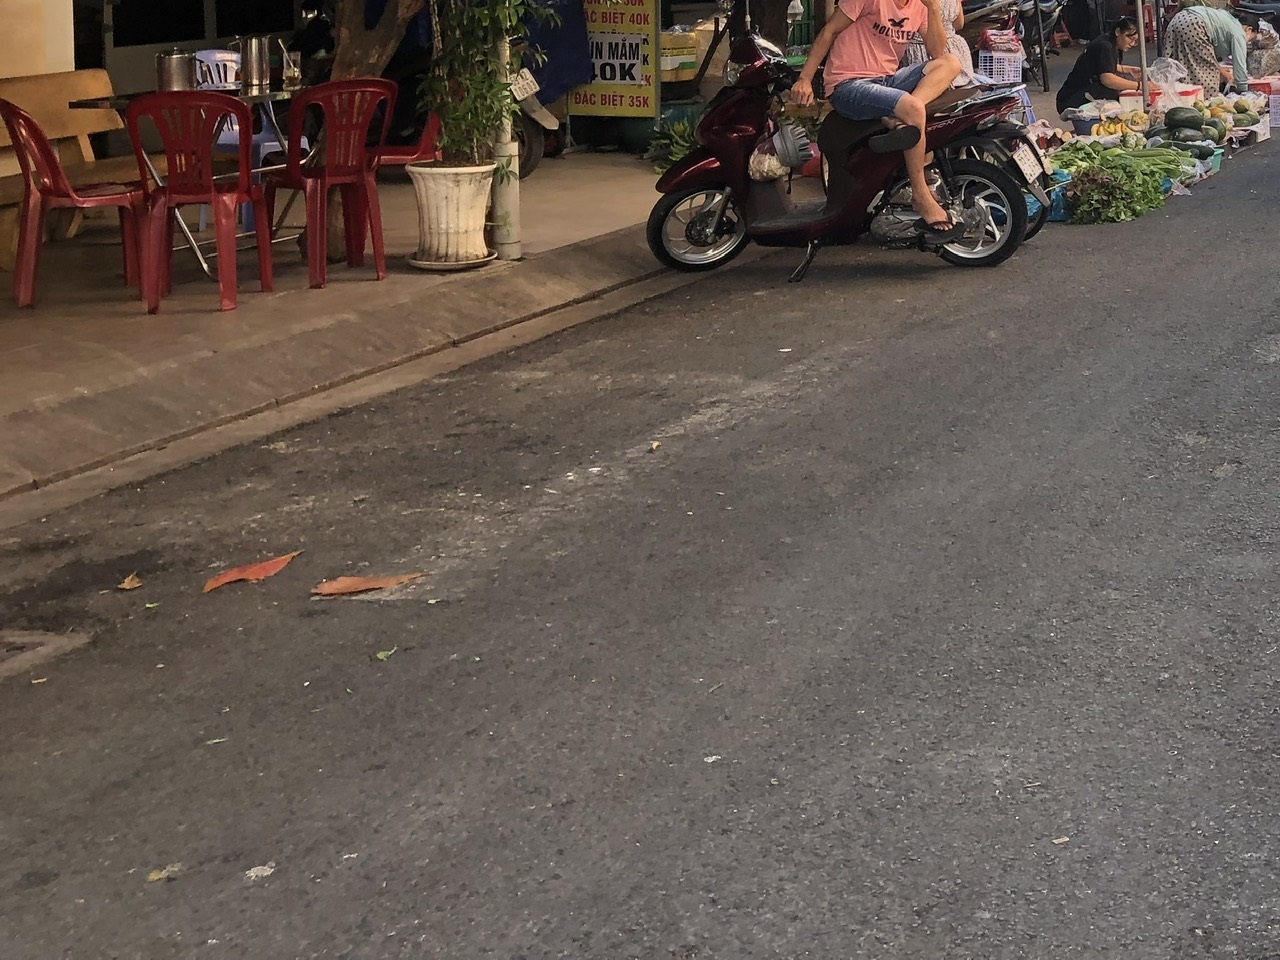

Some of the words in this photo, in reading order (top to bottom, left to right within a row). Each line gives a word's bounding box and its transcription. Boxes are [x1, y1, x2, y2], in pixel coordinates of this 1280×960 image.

[601, 8, 626, 27] BIỆT
[628, 12, 651, 26] 40K
[600, 90, 625, 110] BIỆT
[628, 95, 650, 109] 35K
